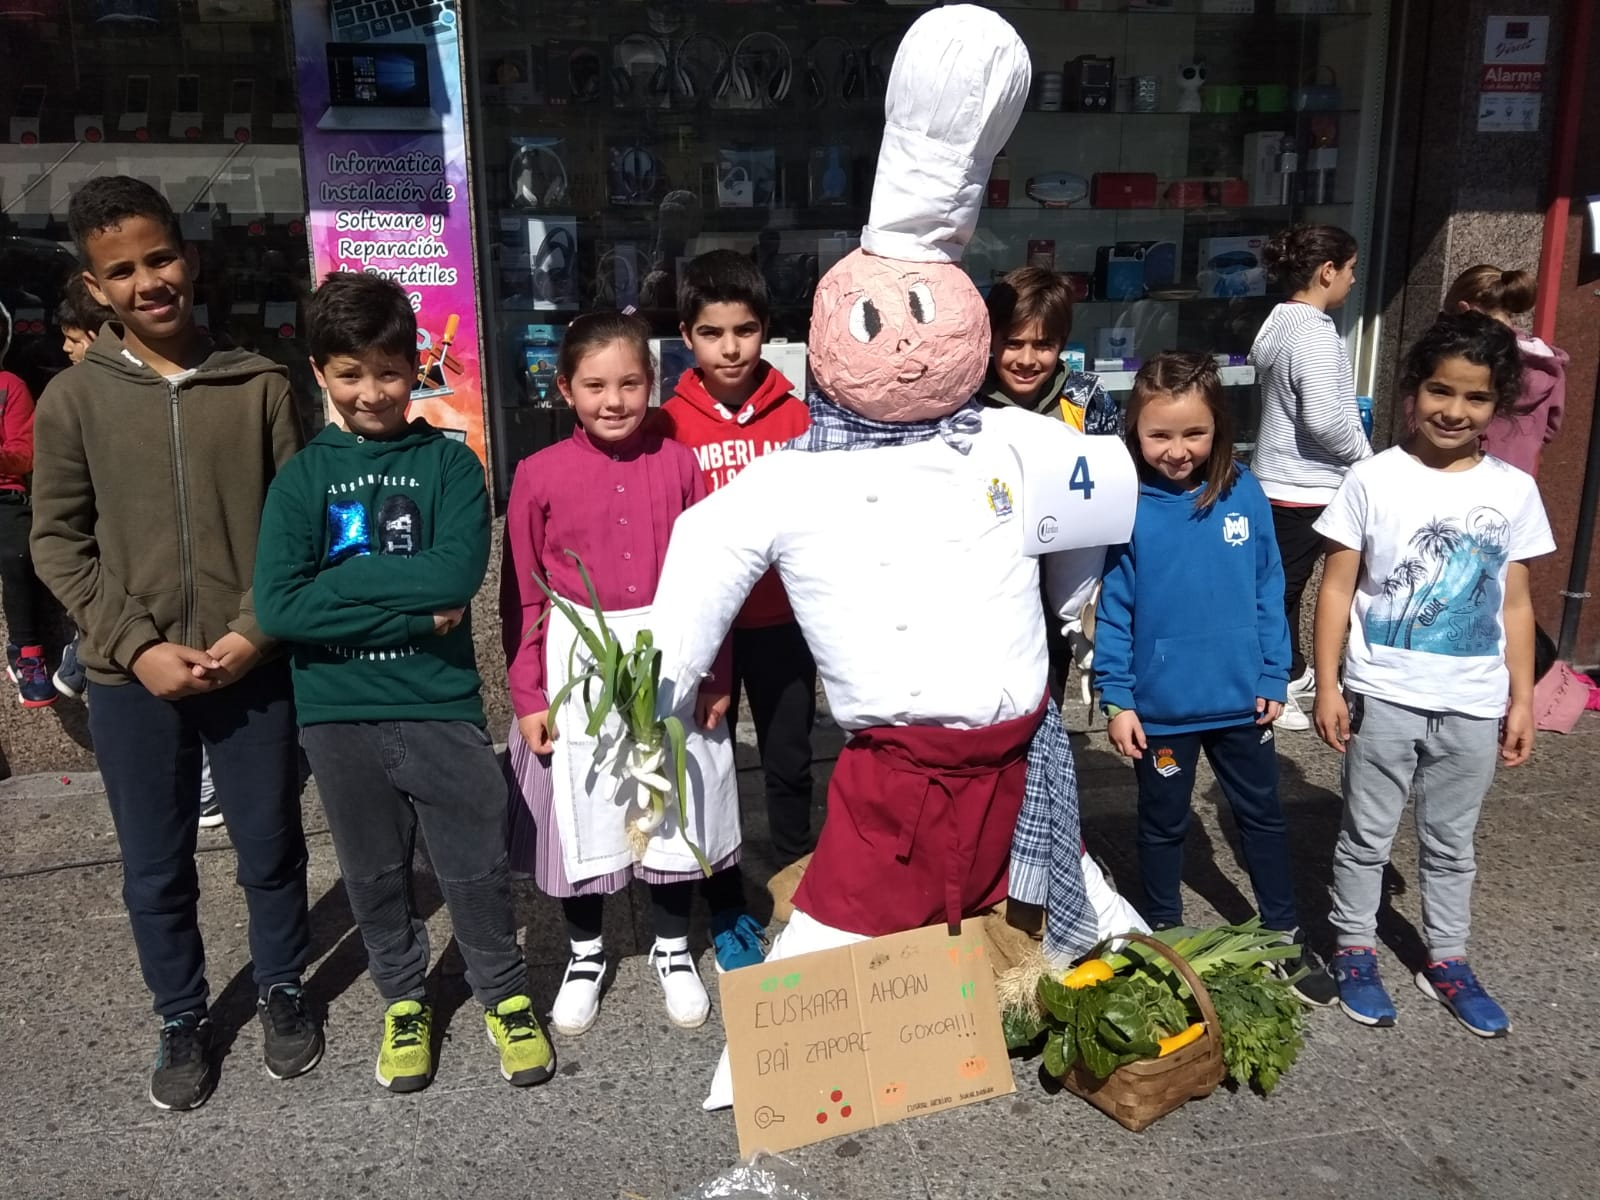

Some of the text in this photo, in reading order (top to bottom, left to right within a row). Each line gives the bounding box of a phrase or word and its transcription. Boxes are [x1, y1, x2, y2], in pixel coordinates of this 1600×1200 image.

[1484, 67, 1541, 82] Alarma
[328, 151, 443, 174] Informatica
[321, 179, 456, 201] Instalación de
[336, 209, 444, 234] Software y
[338, 238, 447, 264] Reparación
[534, 400, 552, 409] JVC
[331, 482, 356, 495] LOS
[1068, 456, 1095, 500] 4
[1418, 598, 1446, 625] ALOHA
[754, 974, 929, 1029] EUSKARA AHOAN
[805, 1031, 873, 1064] ZAPORE
[899, 1013, 977, 1044] GOXOA!!!
